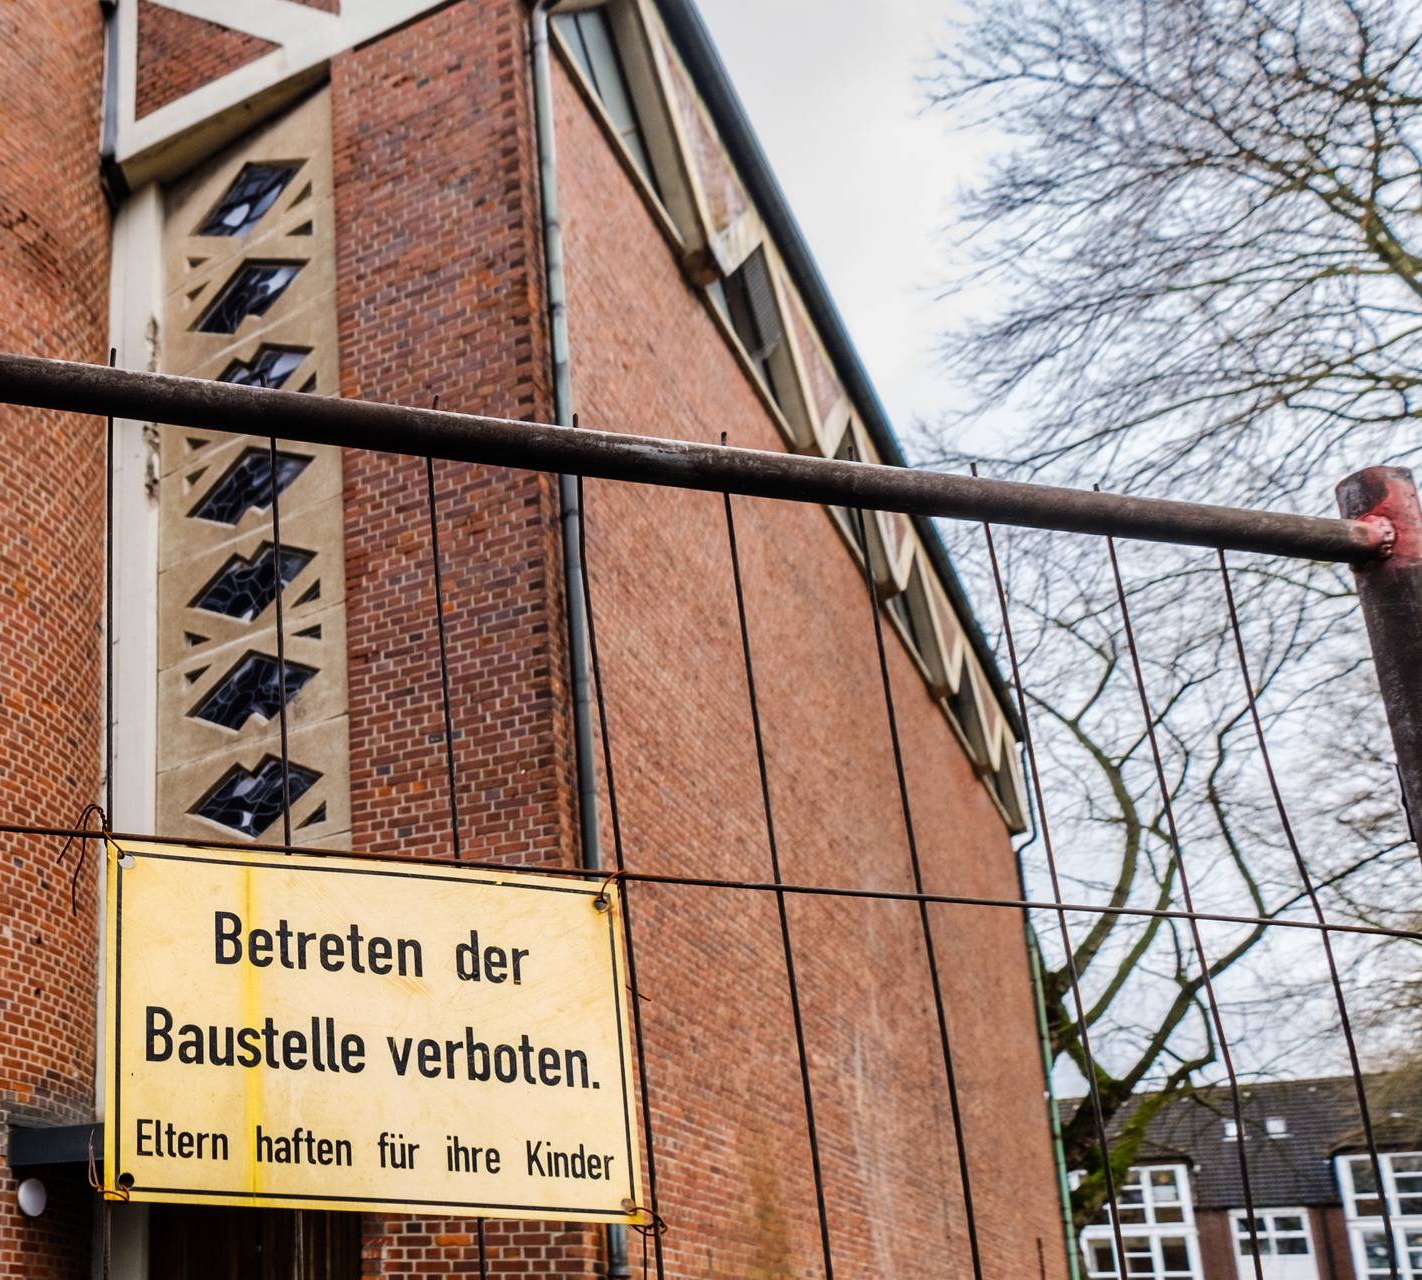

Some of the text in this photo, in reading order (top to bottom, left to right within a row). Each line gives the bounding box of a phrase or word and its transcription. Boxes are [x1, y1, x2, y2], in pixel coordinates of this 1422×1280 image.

[214, 910, 530, 986] Betreten der
[145, 1005, 601, 1090] Baustelle verboten.
[136, 1118, 615, 1181] Eltern haften für ihre Kinder
